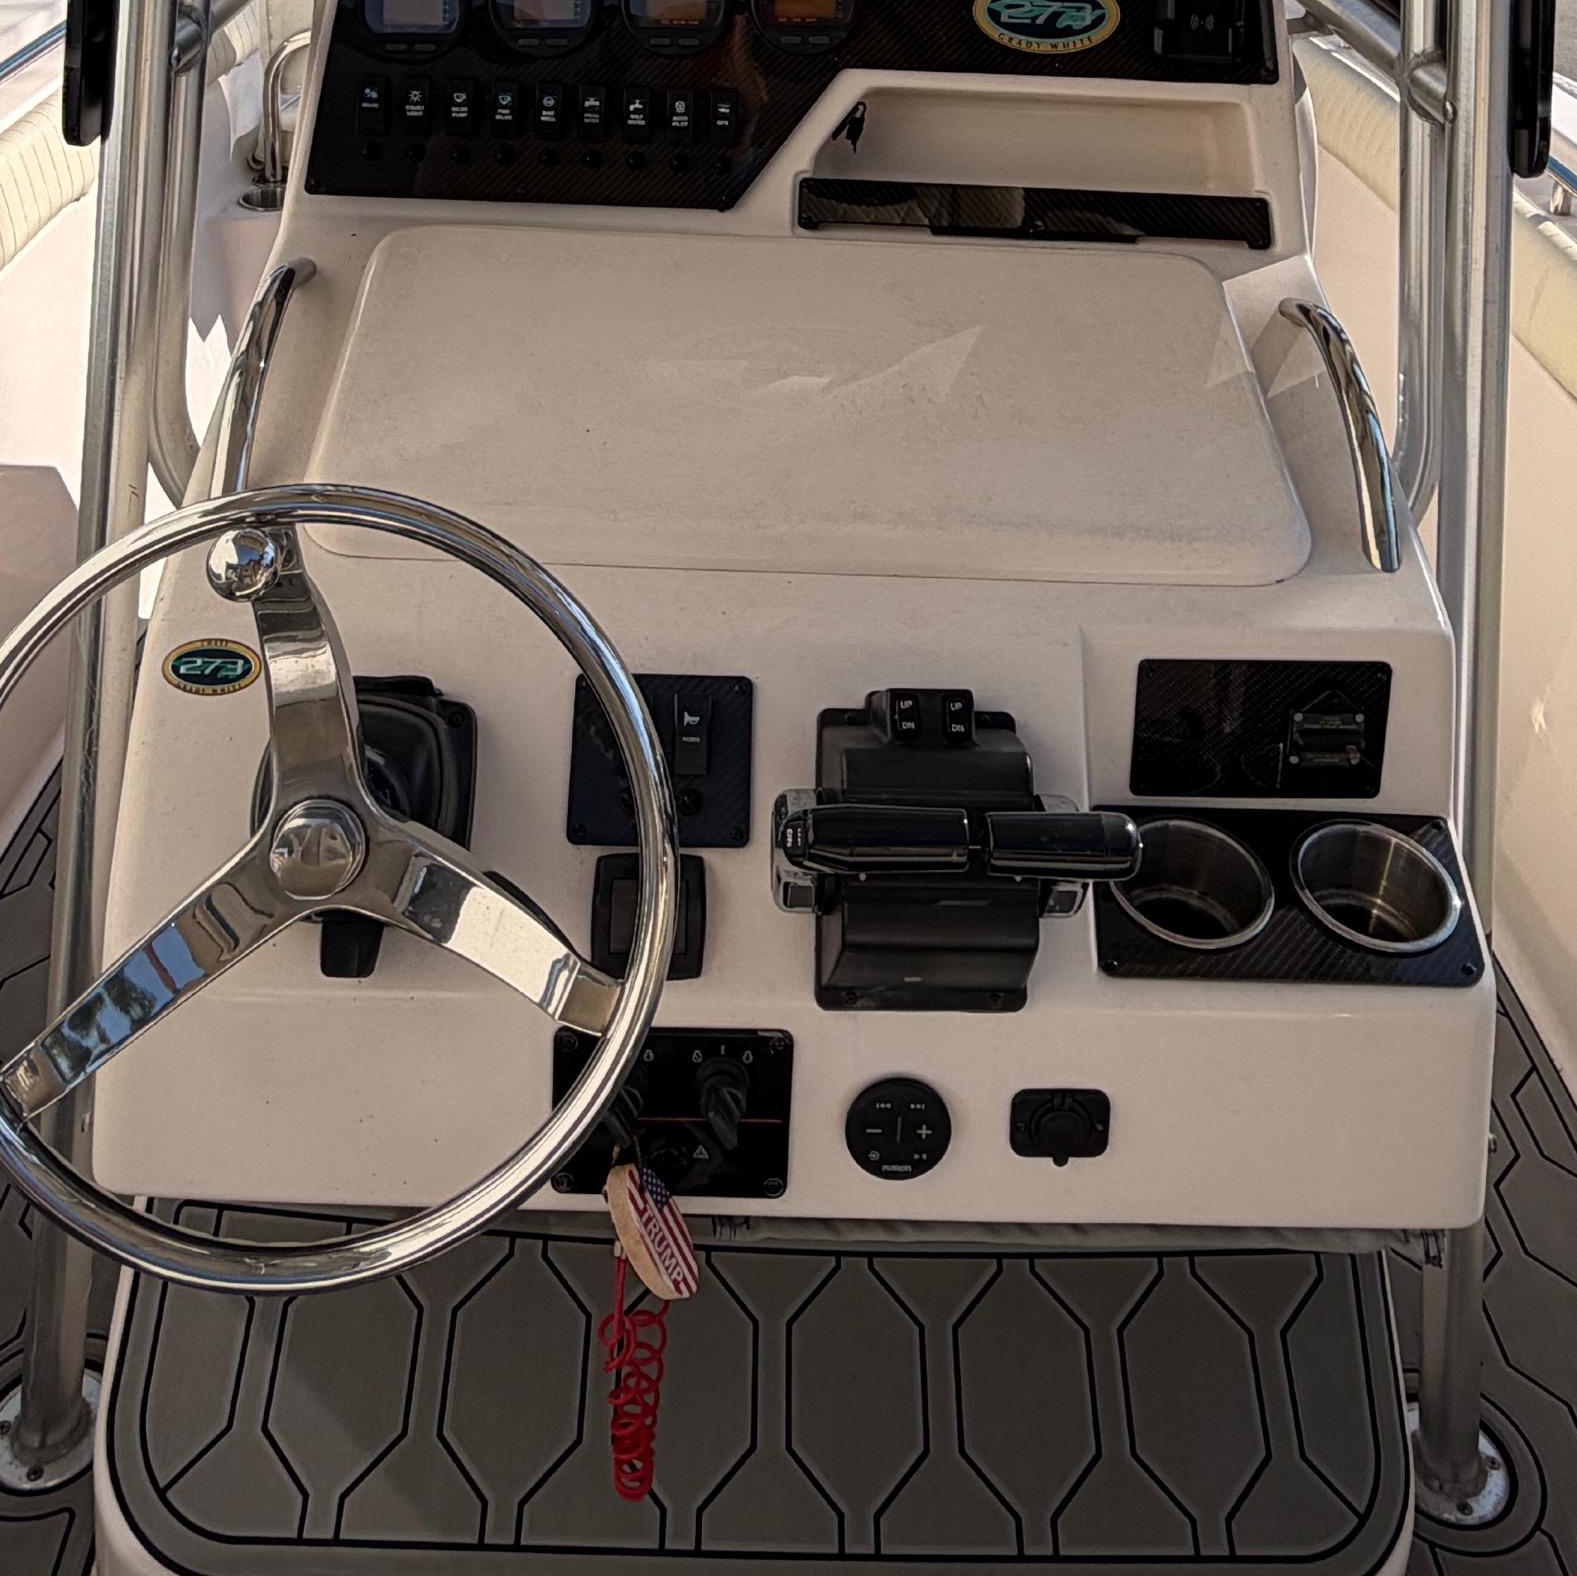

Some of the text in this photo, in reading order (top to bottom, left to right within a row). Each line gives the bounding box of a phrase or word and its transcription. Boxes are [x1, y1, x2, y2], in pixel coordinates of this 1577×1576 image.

[179, 657, 244, 676] 273
[900, 700, 913, 709] UP
[950, 702, 963, 711] UP
[901, 721, 915, 729] DN
[951, 723, 965, 732] DN
[641, 1205, 684, 1282] TRUMP
